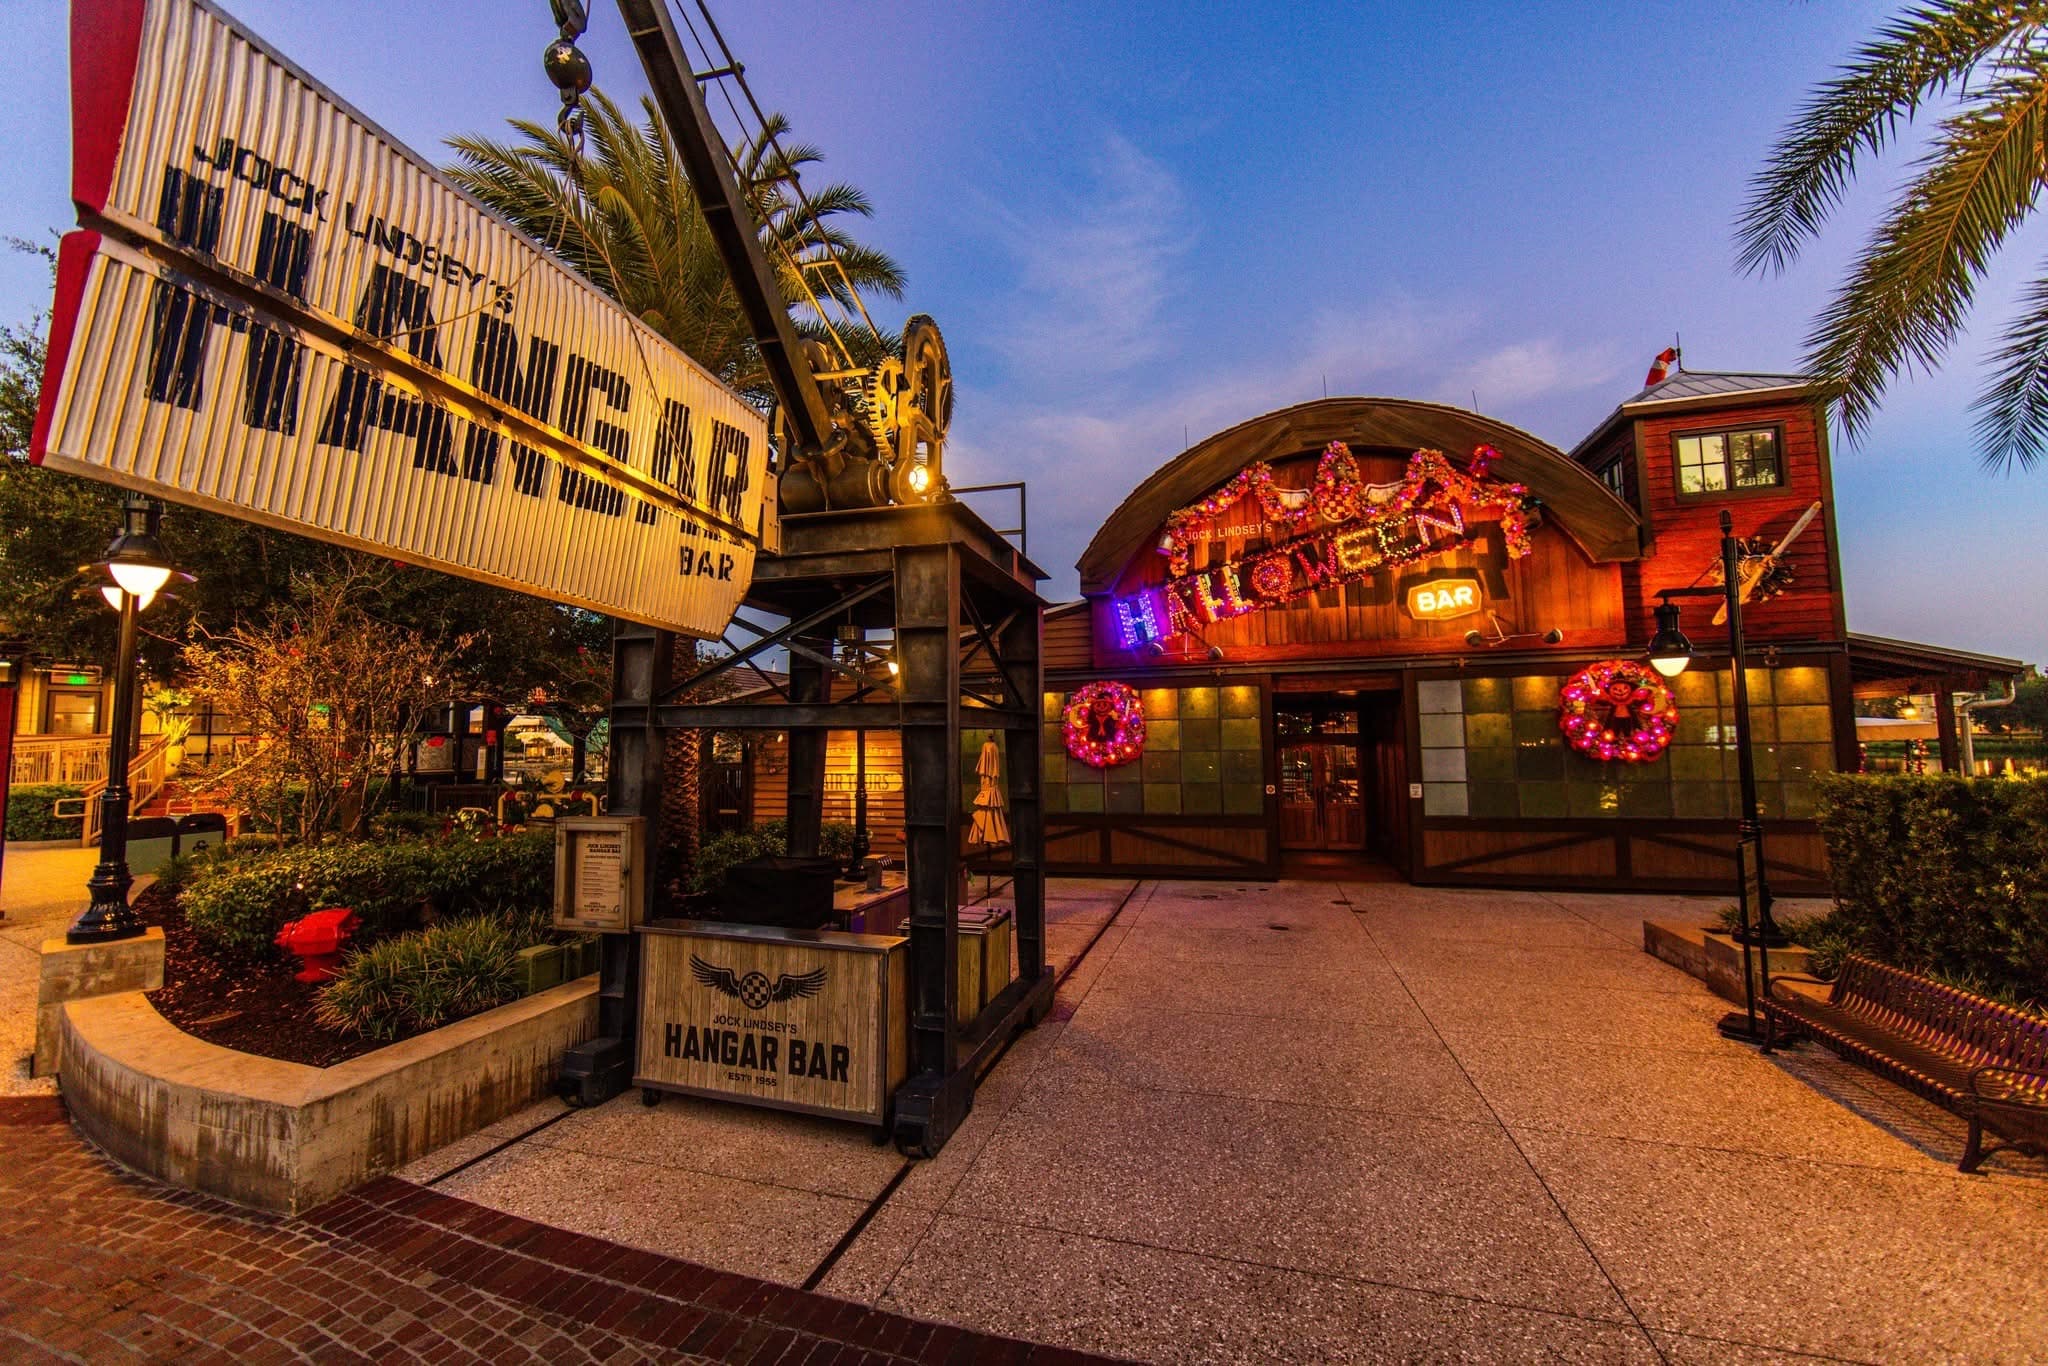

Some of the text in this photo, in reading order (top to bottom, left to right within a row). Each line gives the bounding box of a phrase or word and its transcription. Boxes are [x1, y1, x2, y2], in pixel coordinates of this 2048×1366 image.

[193, 137, 514, 315] JOCK LINDSEY'S
[143, 164, 749, 548] HANGAR
[1186, 520, 1273, 542] JOCK LINDSEY'S
[679, 546, 735, 582] BAR
[1116, 502, 1465, 647] HALLOWEEN
[1416, 586, 1474, 613] BAR
[846, 773, 890, 791] TURS
[713, 1014, 798, 1035] JOCK LINDSEY'S
[664, 1022, 851, 1084] HANGAR BAR
[755, 1075, 777, 1087] 1955
